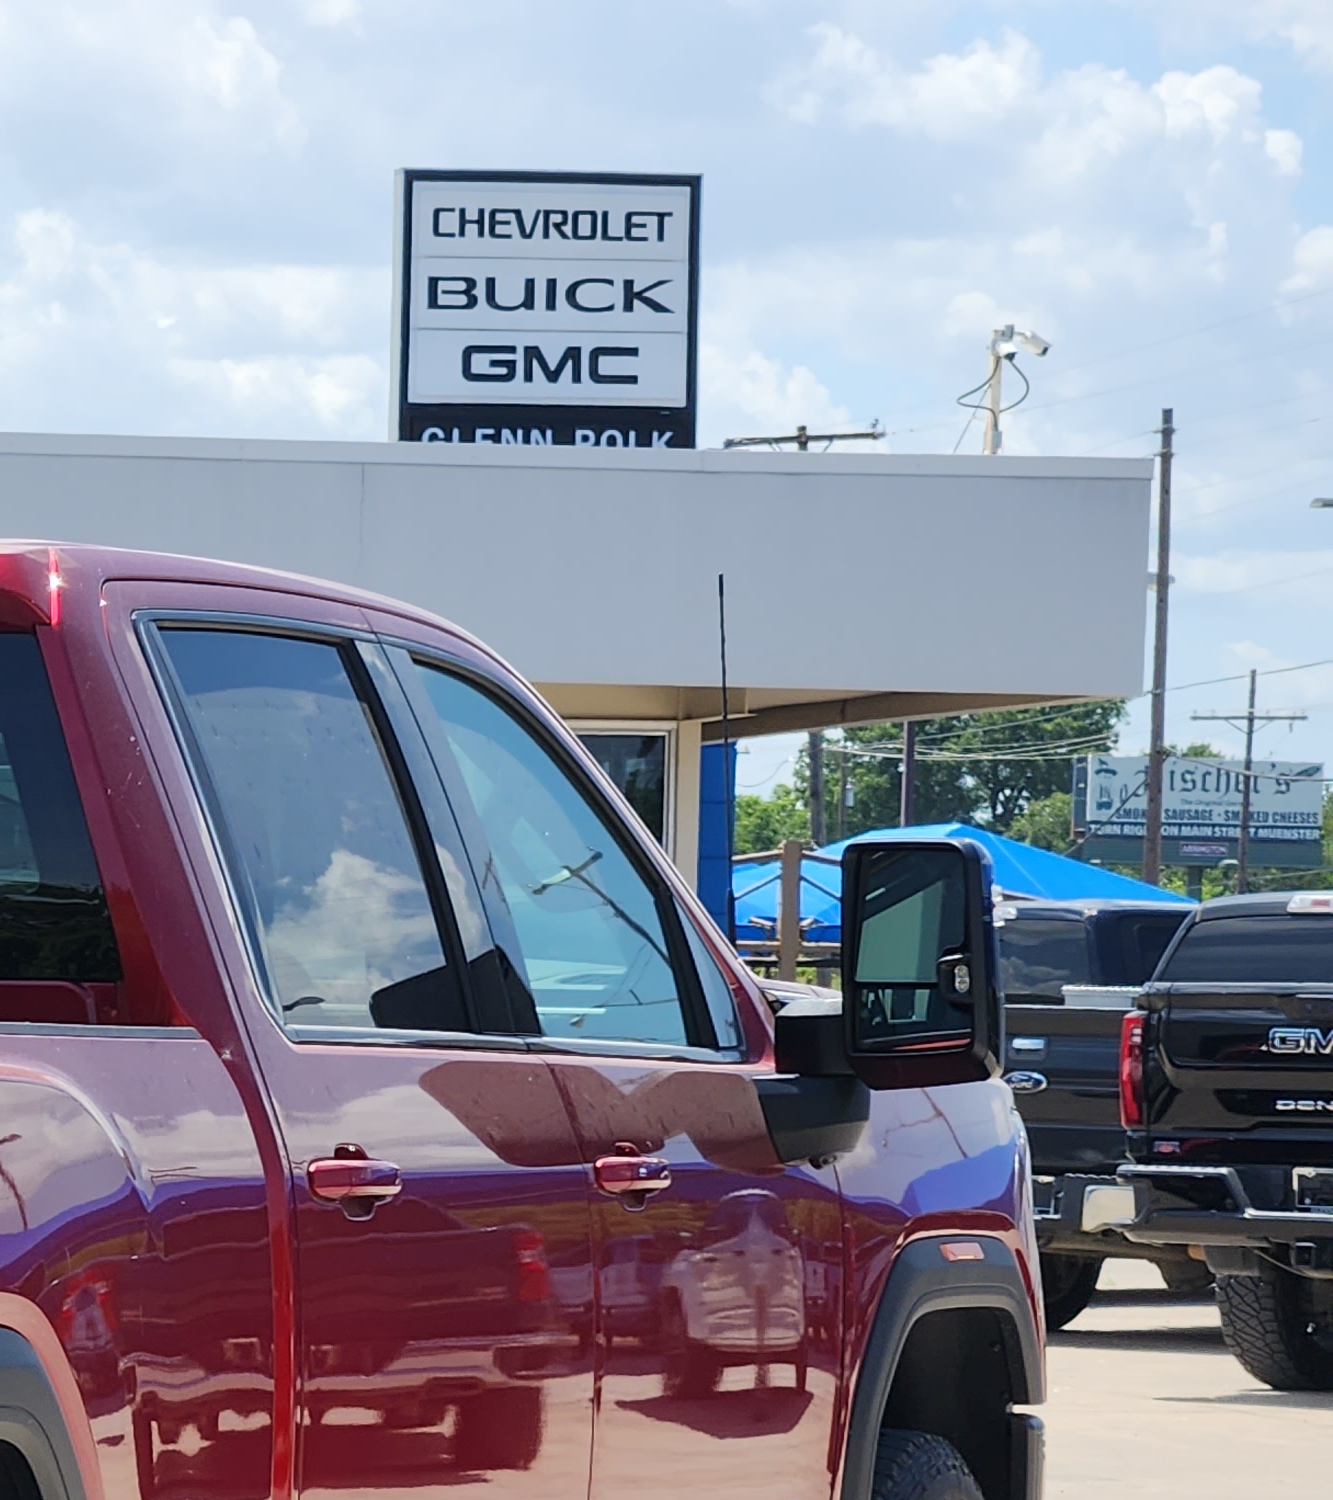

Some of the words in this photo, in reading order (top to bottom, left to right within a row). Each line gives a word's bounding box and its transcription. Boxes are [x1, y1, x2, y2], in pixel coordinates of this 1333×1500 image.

[432, 207, 673, 242] CHEVROLET
[427, 276, 675, 314] BUICK
[461, 344, 639, 385] GMC
[1164, 808, 1213, 821] SAUSAGE
[1223, 809, 1269, 823] SMKED
[1271, 812, 1319, 824] CHEESES
[1161, 825, 1179, 836] ON
[1214, 826, 1257, 837] STRET
[1269, 1027, 1333, 1054] GM
[1275, 1100, 1333, 1111] DEN
